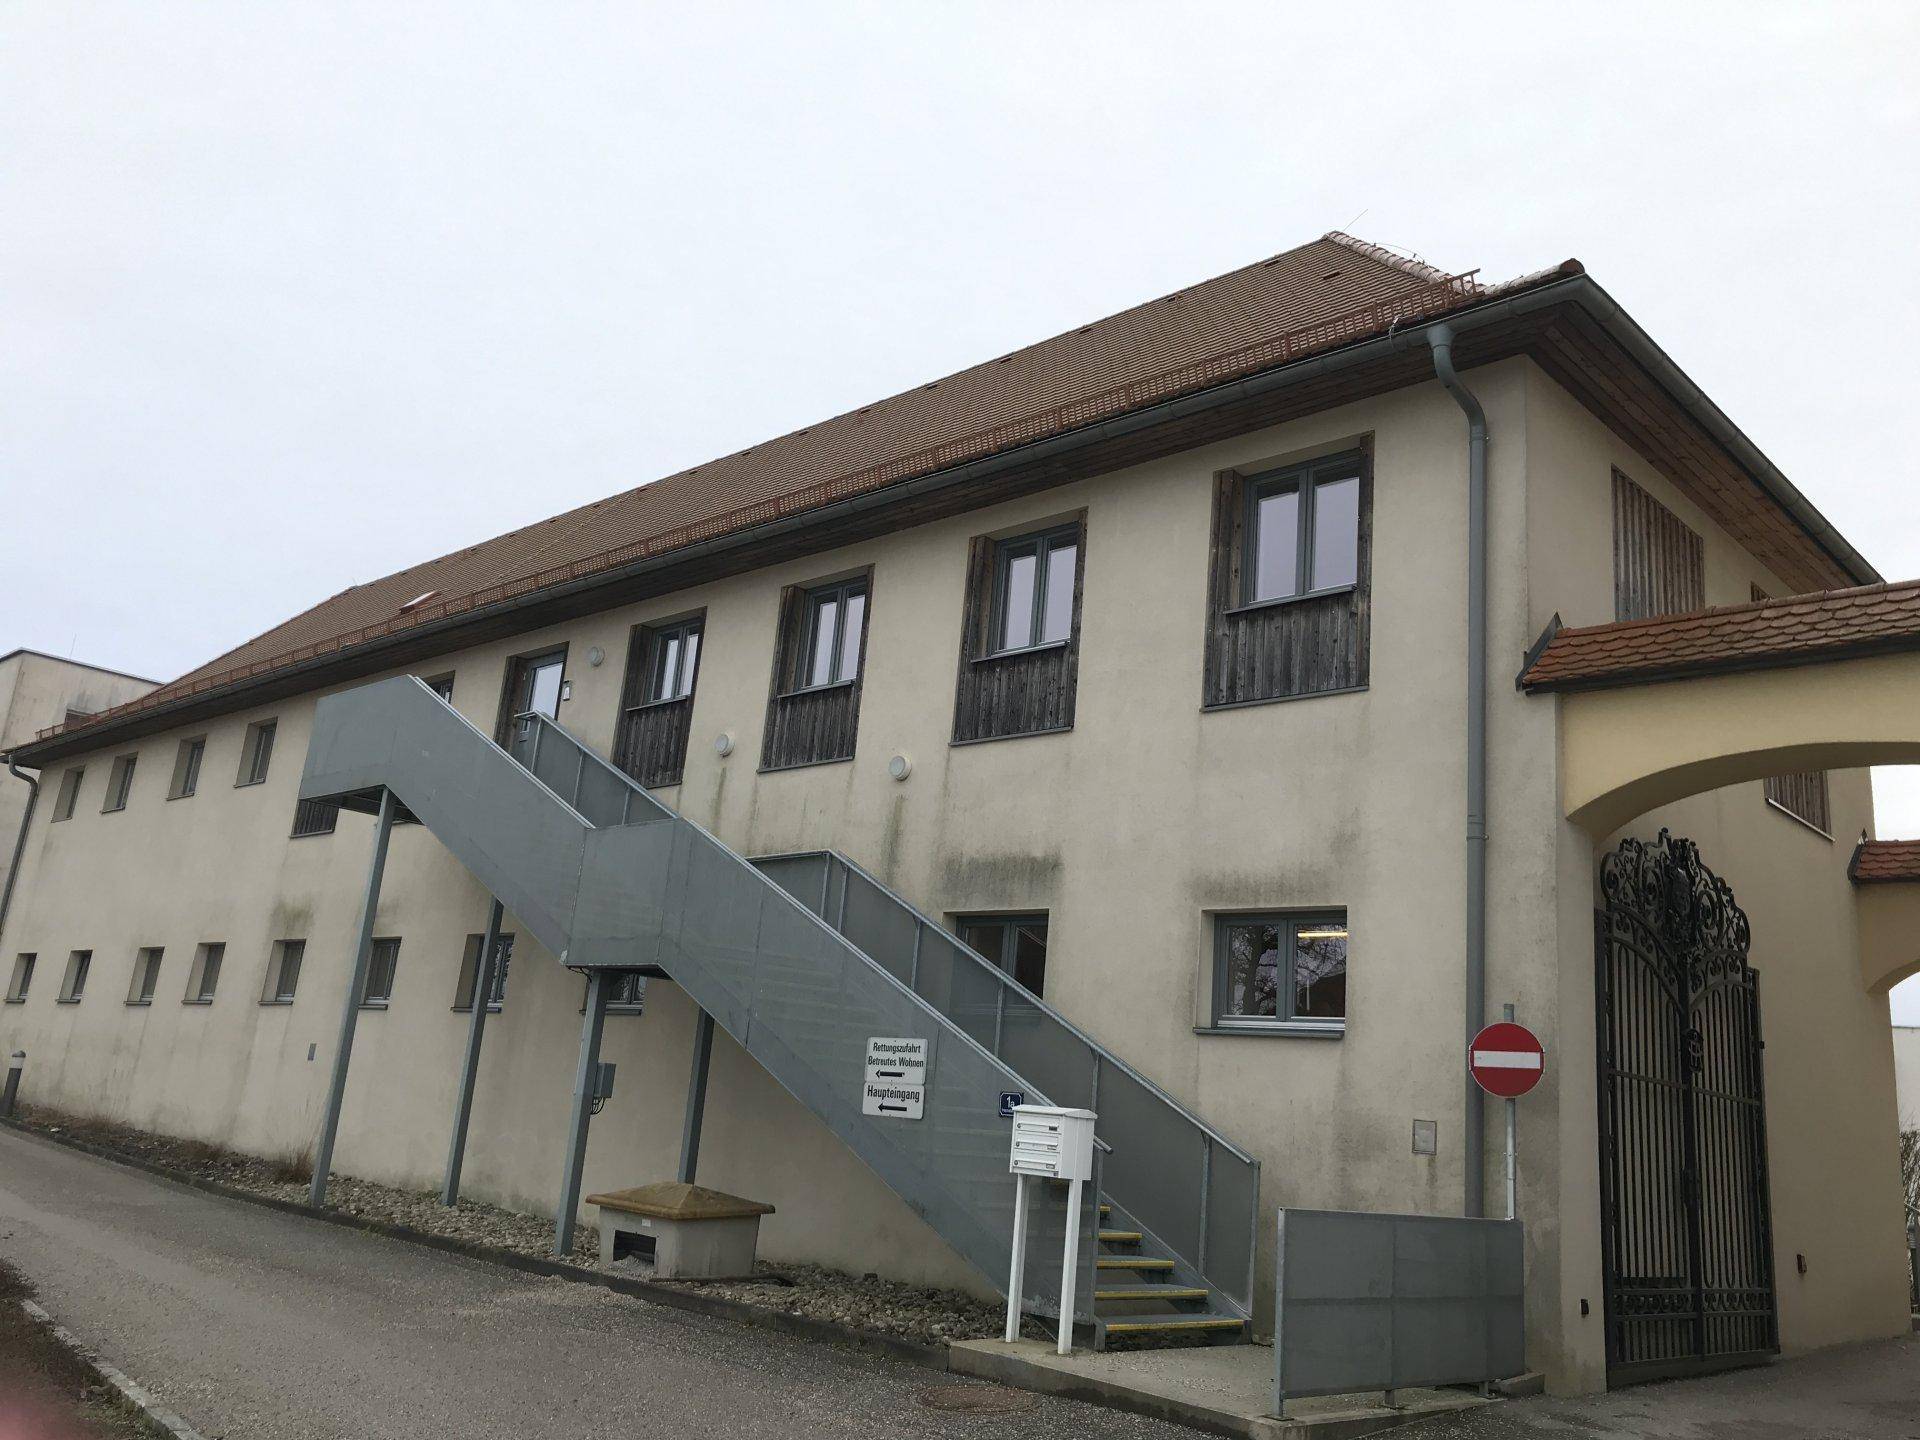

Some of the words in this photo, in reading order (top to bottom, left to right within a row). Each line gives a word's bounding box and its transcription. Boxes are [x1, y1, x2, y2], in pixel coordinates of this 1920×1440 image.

[873, 1042, 921, 1054] Rettungszufahrt
[868, 1055, 897, 1067] Betreutes
[899, 1056, 924, 1068] Wohnen
[867, 1085, 920, 1103] Haupteingang
